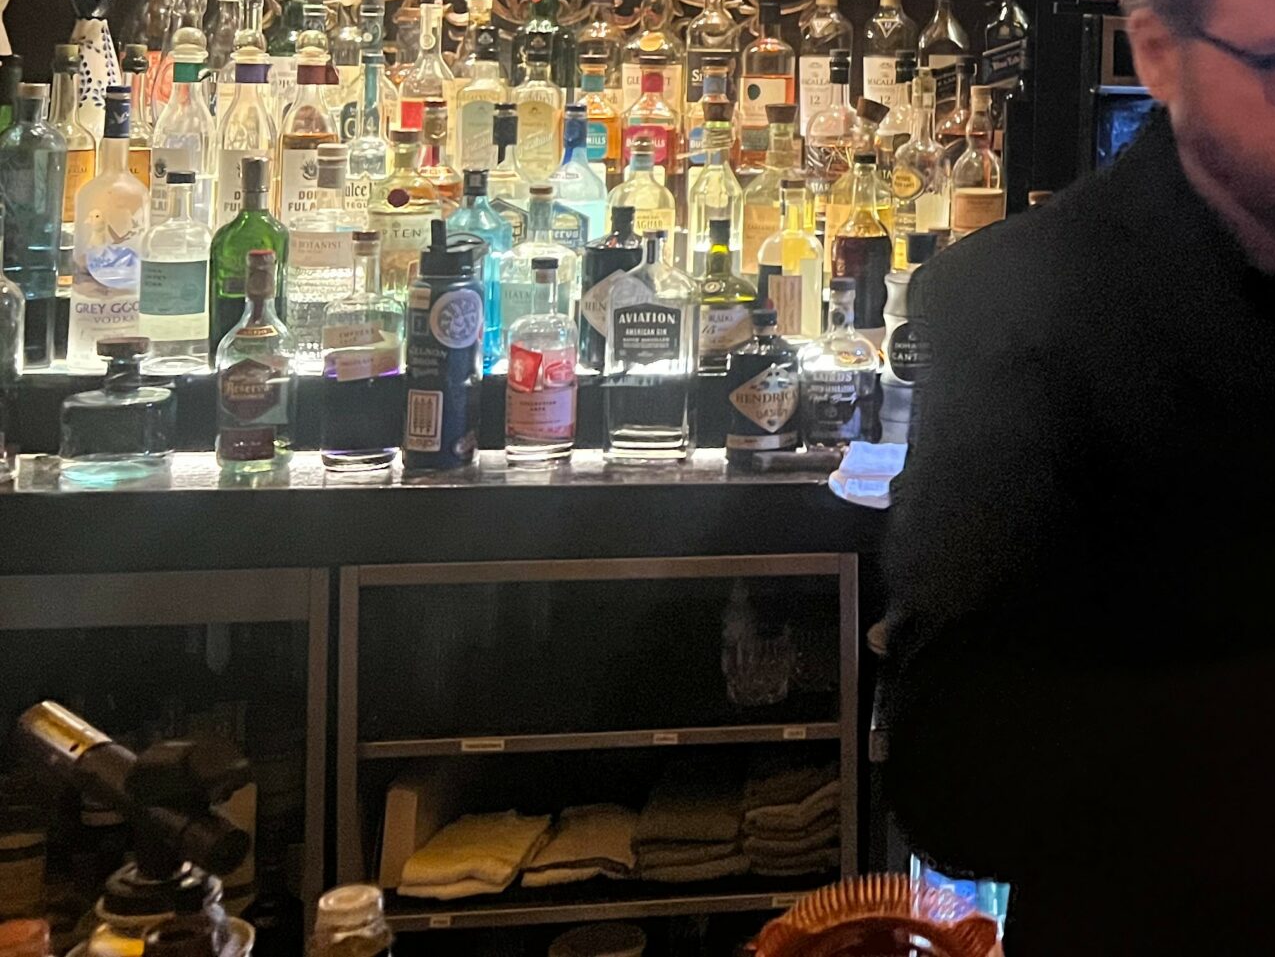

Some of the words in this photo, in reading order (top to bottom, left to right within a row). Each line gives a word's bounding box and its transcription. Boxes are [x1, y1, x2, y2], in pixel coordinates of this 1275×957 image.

[809, 95, 820, 105] 12
[879, 94, 891, 105] 12
[393, 229, 422, 238] TEN
[75, 302, 106, 315] GREY
[618, 311, 676, 324] AVIATION
